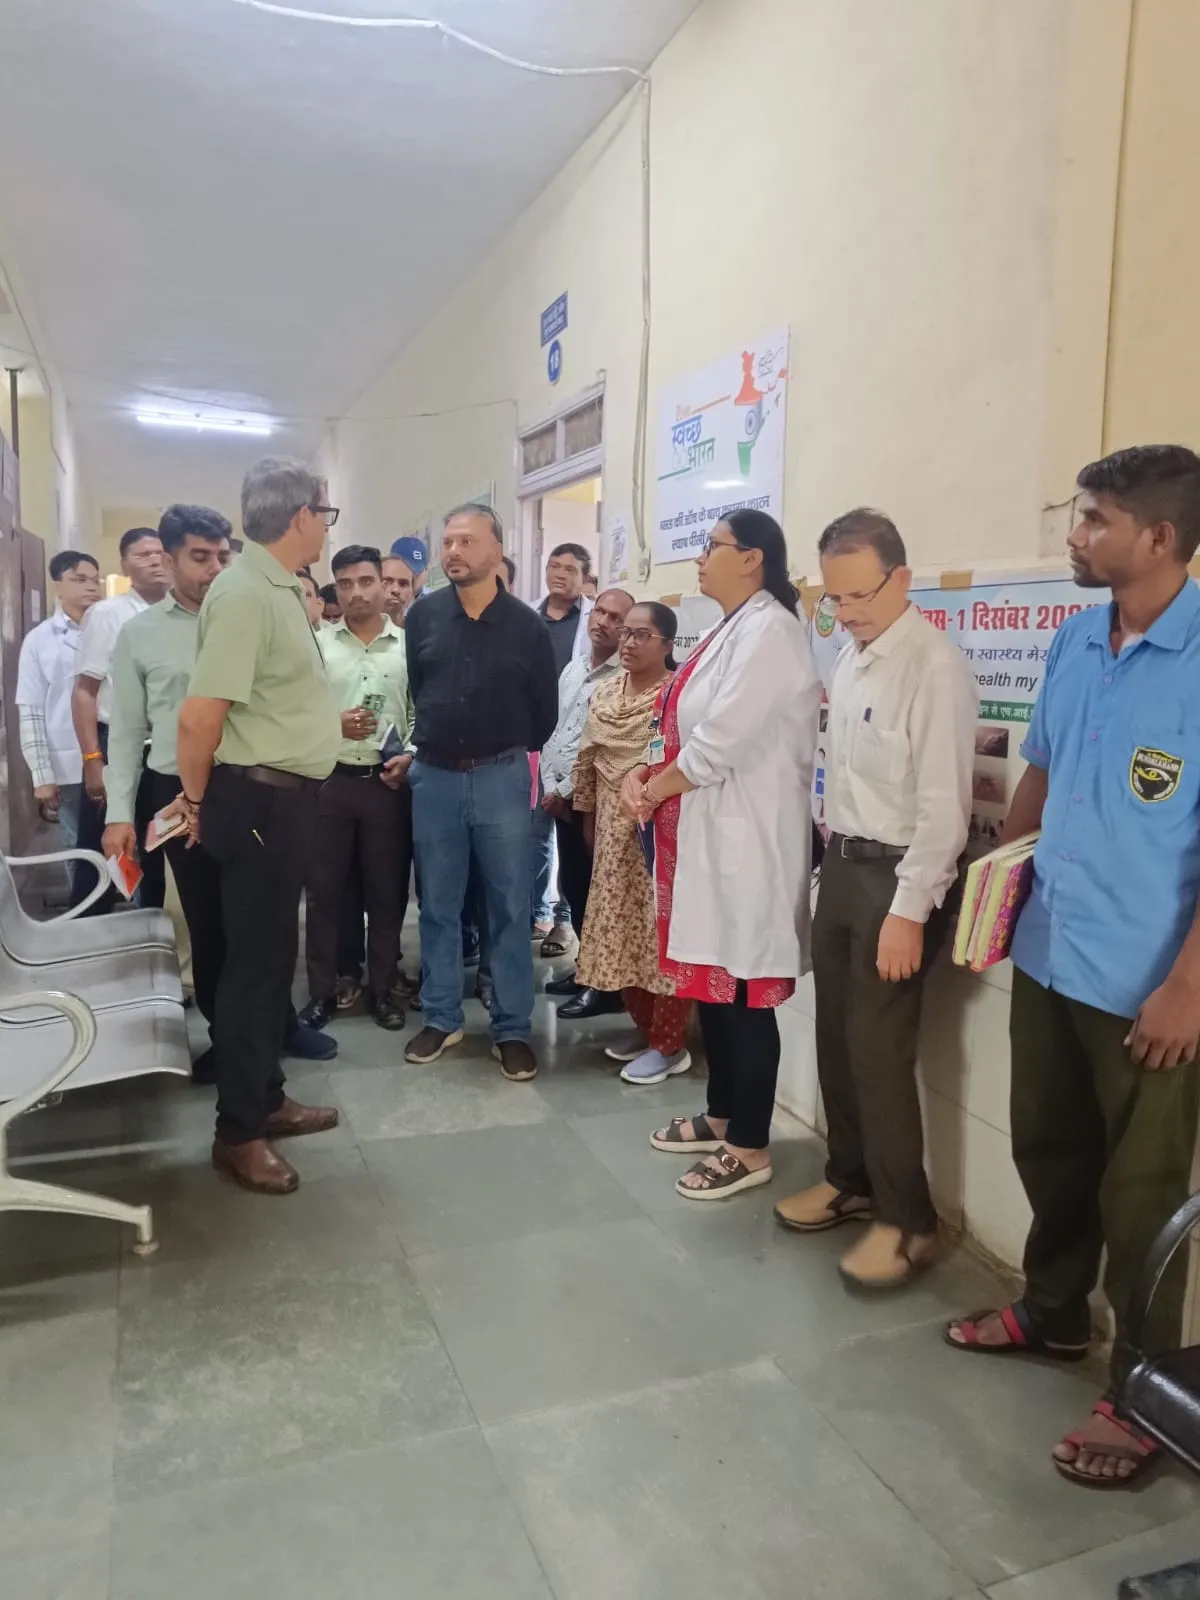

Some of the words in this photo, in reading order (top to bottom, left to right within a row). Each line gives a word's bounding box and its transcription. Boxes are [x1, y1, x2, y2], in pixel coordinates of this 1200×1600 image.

[672, 414, 702, 446] स्वच्छ
[687, 437, 716, 468] भारत
[972, 600, 1031, 631] दिसंबर
[977, 647, 1022, 662] स्वास्थ्य
[1027, 644, 1049, 662] मेर
[1014, 675, 1038, 693] my
